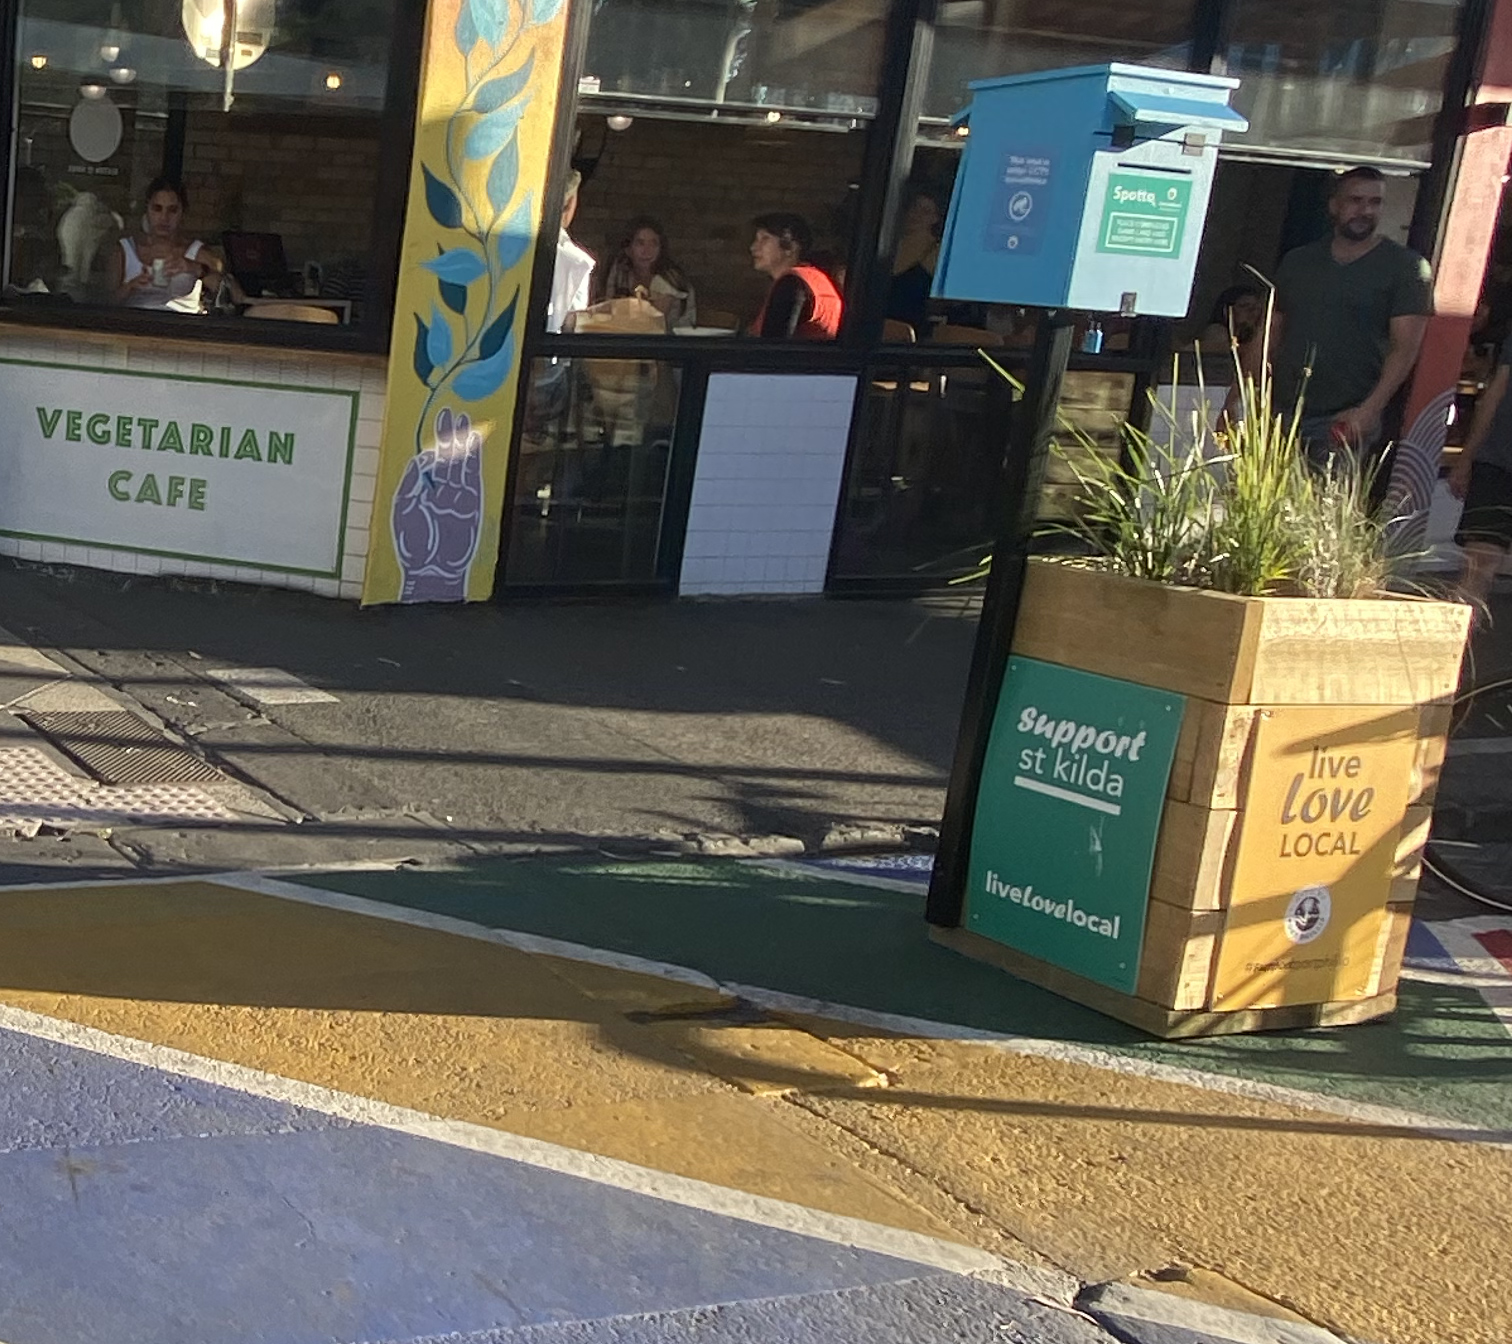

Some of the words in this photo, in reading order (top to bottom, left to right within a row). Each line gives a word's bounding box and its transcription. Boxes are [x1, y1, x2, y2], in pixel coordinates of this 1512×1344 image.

[36, 406, 296, 465] VEGETARIAN
[107, 470, 208, 511] CAFE
[1017, 706, 1146, 762] support
[1018, 747, 1047, 775] st
[1053, 747, 1124, 798] kilda
[1309, 745, 1362, 779] live
[1279, 831, 1361, 858] LOCAL
